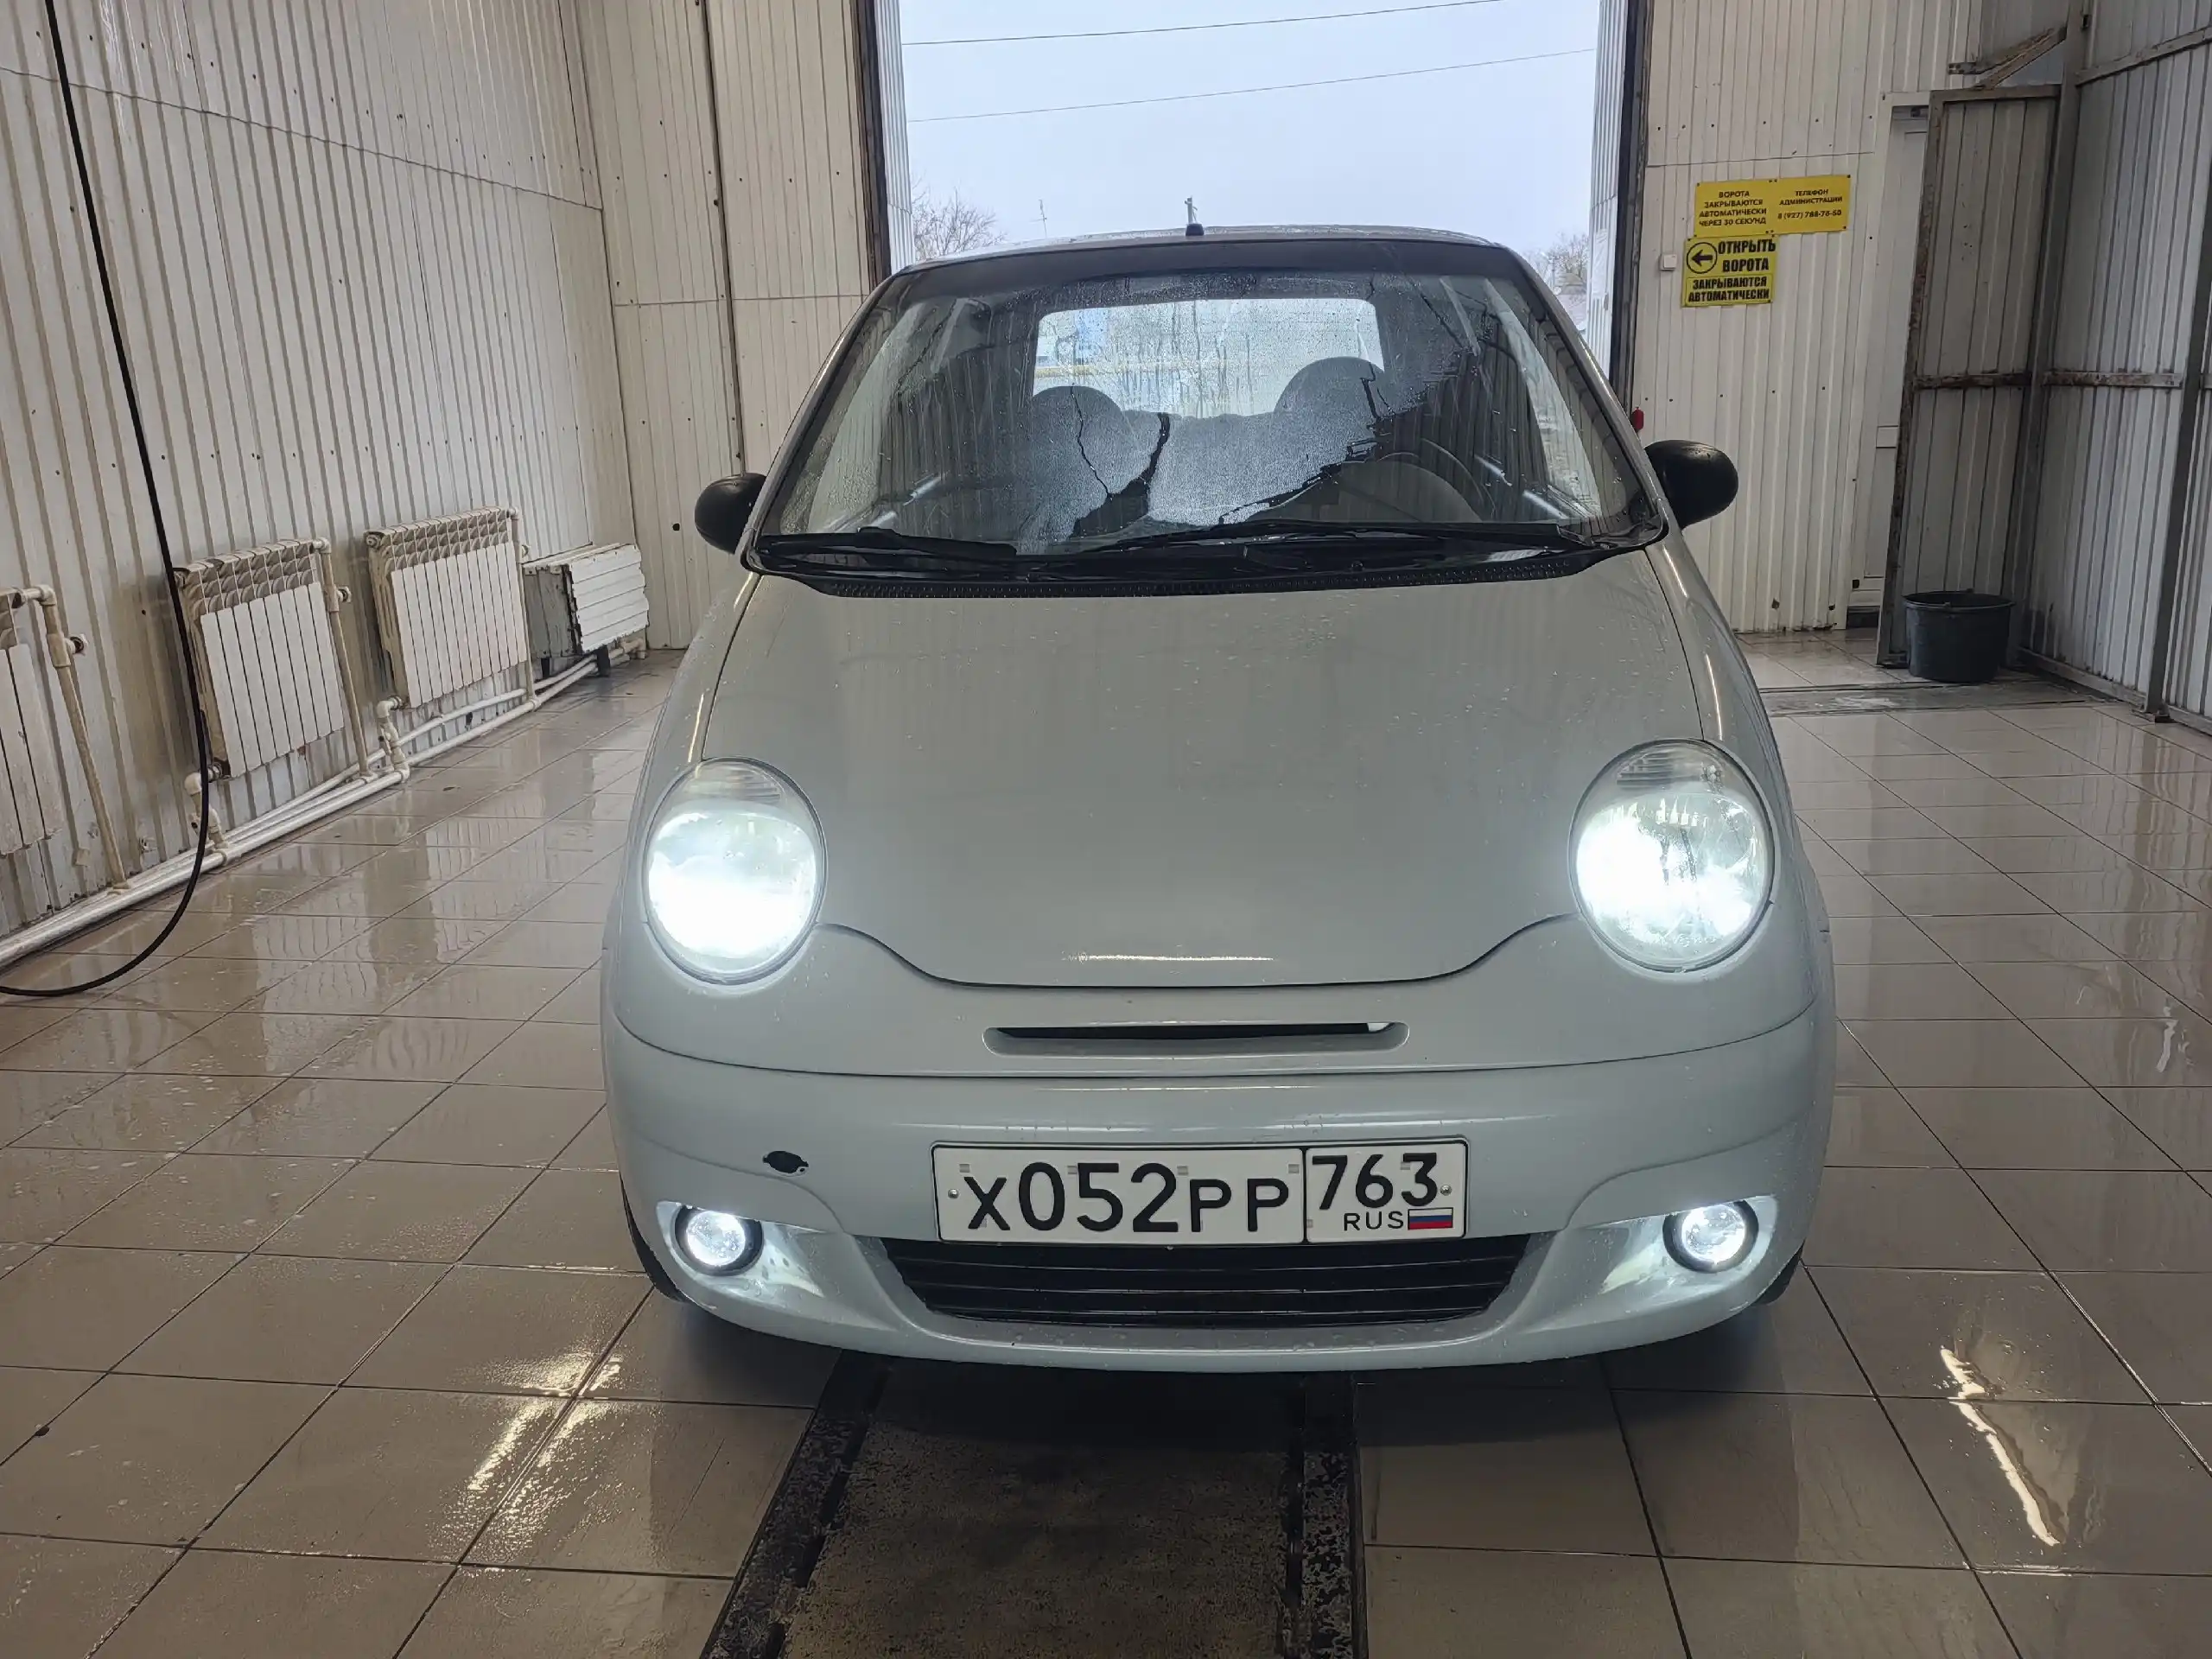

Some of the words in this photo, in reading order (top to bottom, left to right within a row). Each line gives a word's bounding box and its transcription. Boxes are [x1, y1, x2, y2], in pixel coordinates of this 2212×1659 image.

[1704, 199, 1764, 208] ЗАКРЫВАЮТСЯ
[1779, 196, 1842, 206] АДМИНИСТРАЦИИ
[1699, 208, 1767, 218] АВТОМАТИЧЕСКИ
[1699, 219, 1722, 227] ЧЕРЕЗ
[1718, 238, 1777, 254] ОТКРЫТЬ
[1722, 257, 1770, 272] ВОРОТА
[1693, 276, 1767, 289] ЗАКРЫВАЮТСЯ
[1688, 289, 1770, 302] АВТОМАТИЧЕСКИ
[1311, 1152, 1439, 1211] 763
[1344, 1211, 1405, 1231] RUS
